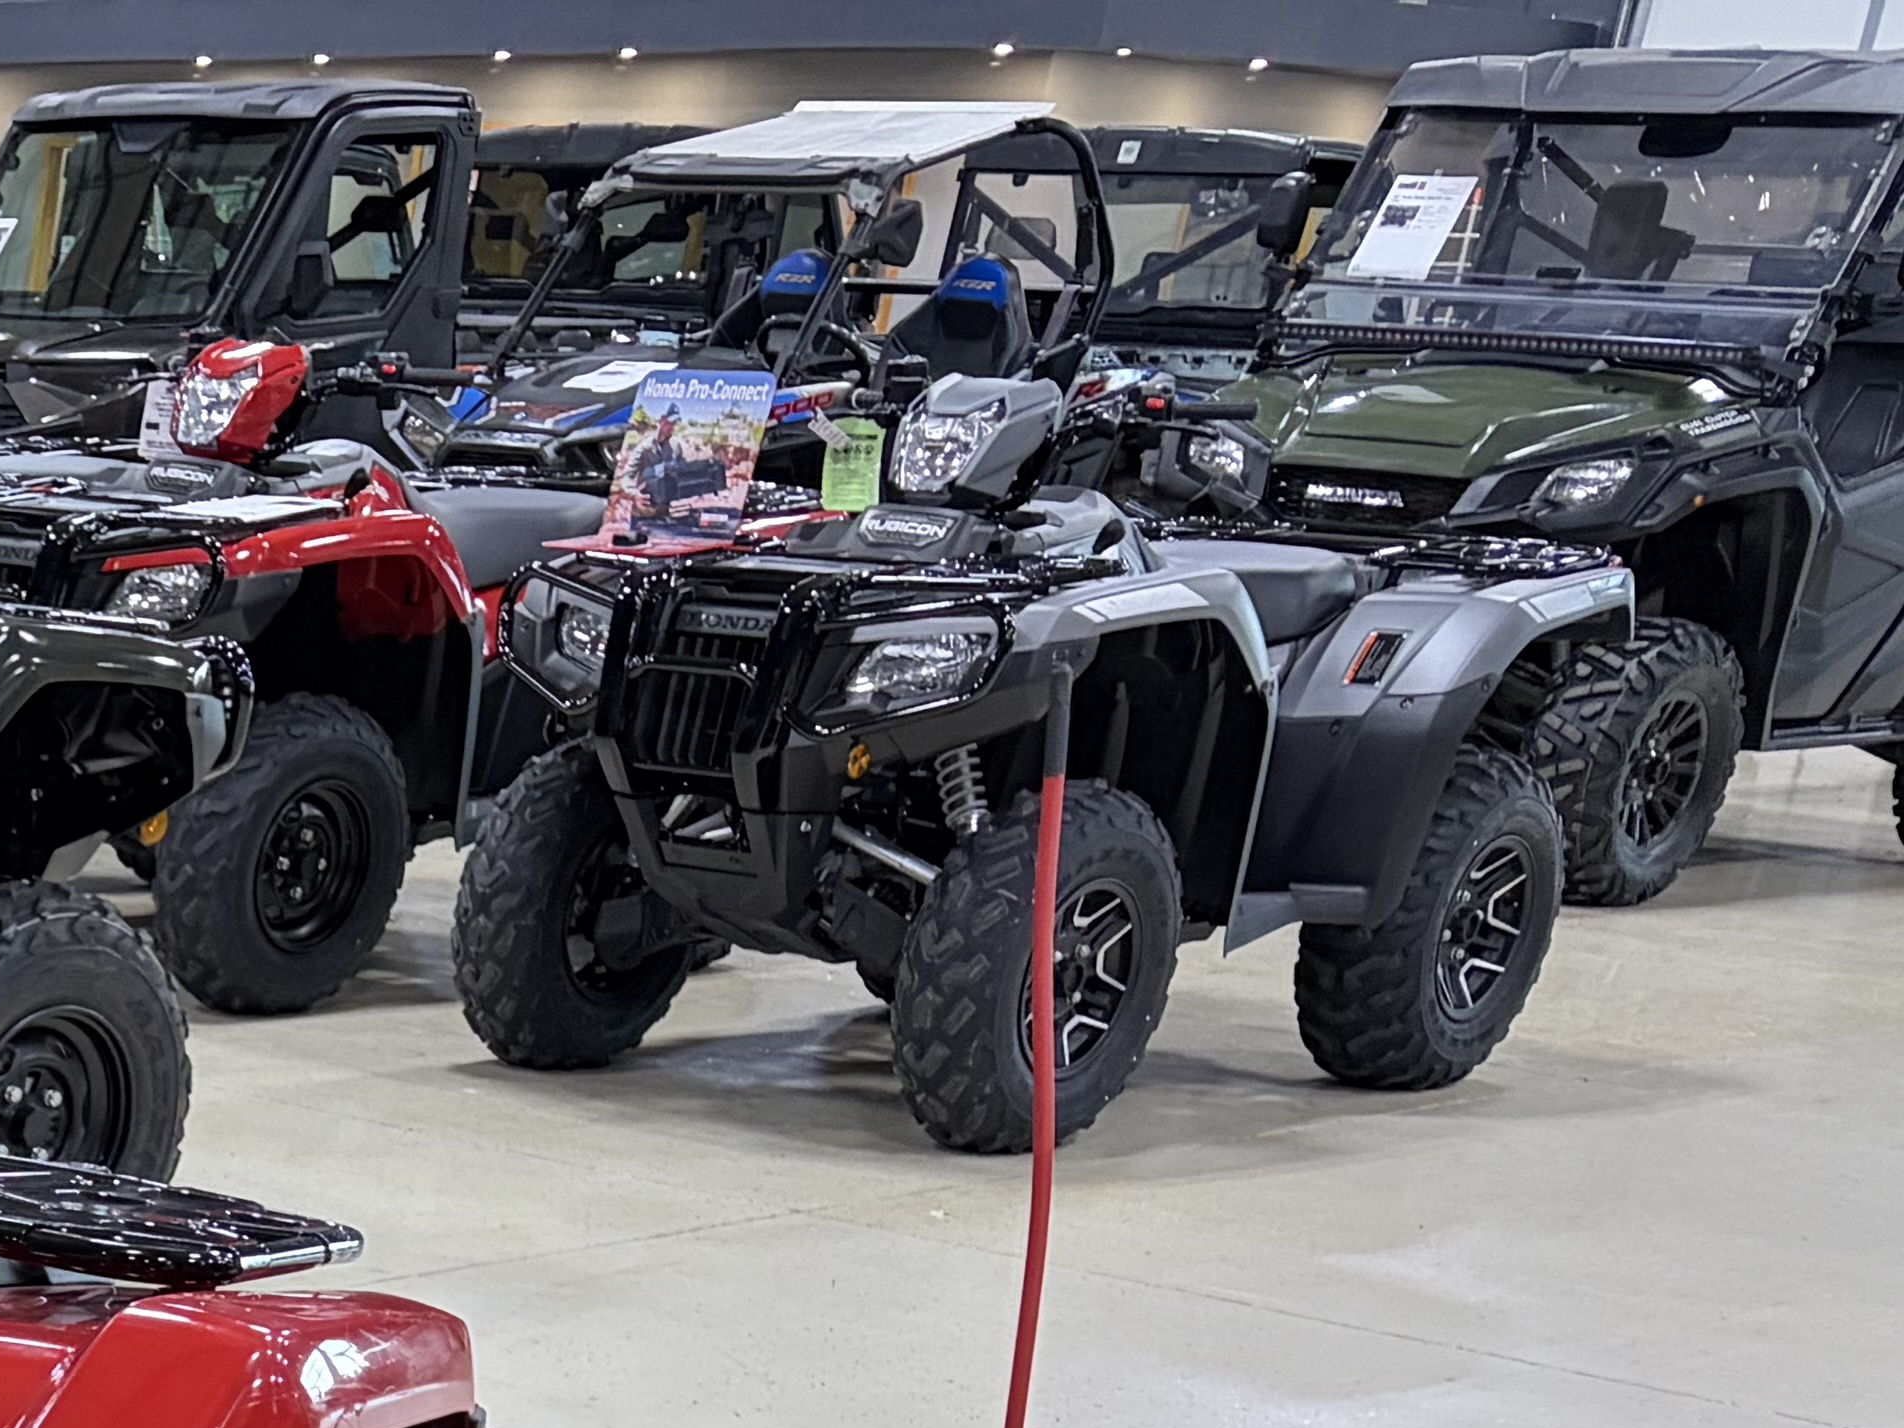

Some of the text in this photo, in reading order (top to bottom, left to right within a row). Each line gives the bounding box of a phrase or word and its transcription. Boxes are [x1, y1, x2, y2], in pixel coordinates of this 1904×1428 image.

[644, 379, 769, 401] Honda Pro-Connect
[150, 466, 214, 486] RUBICON
[861, 515, 951, 539] RUBICON
